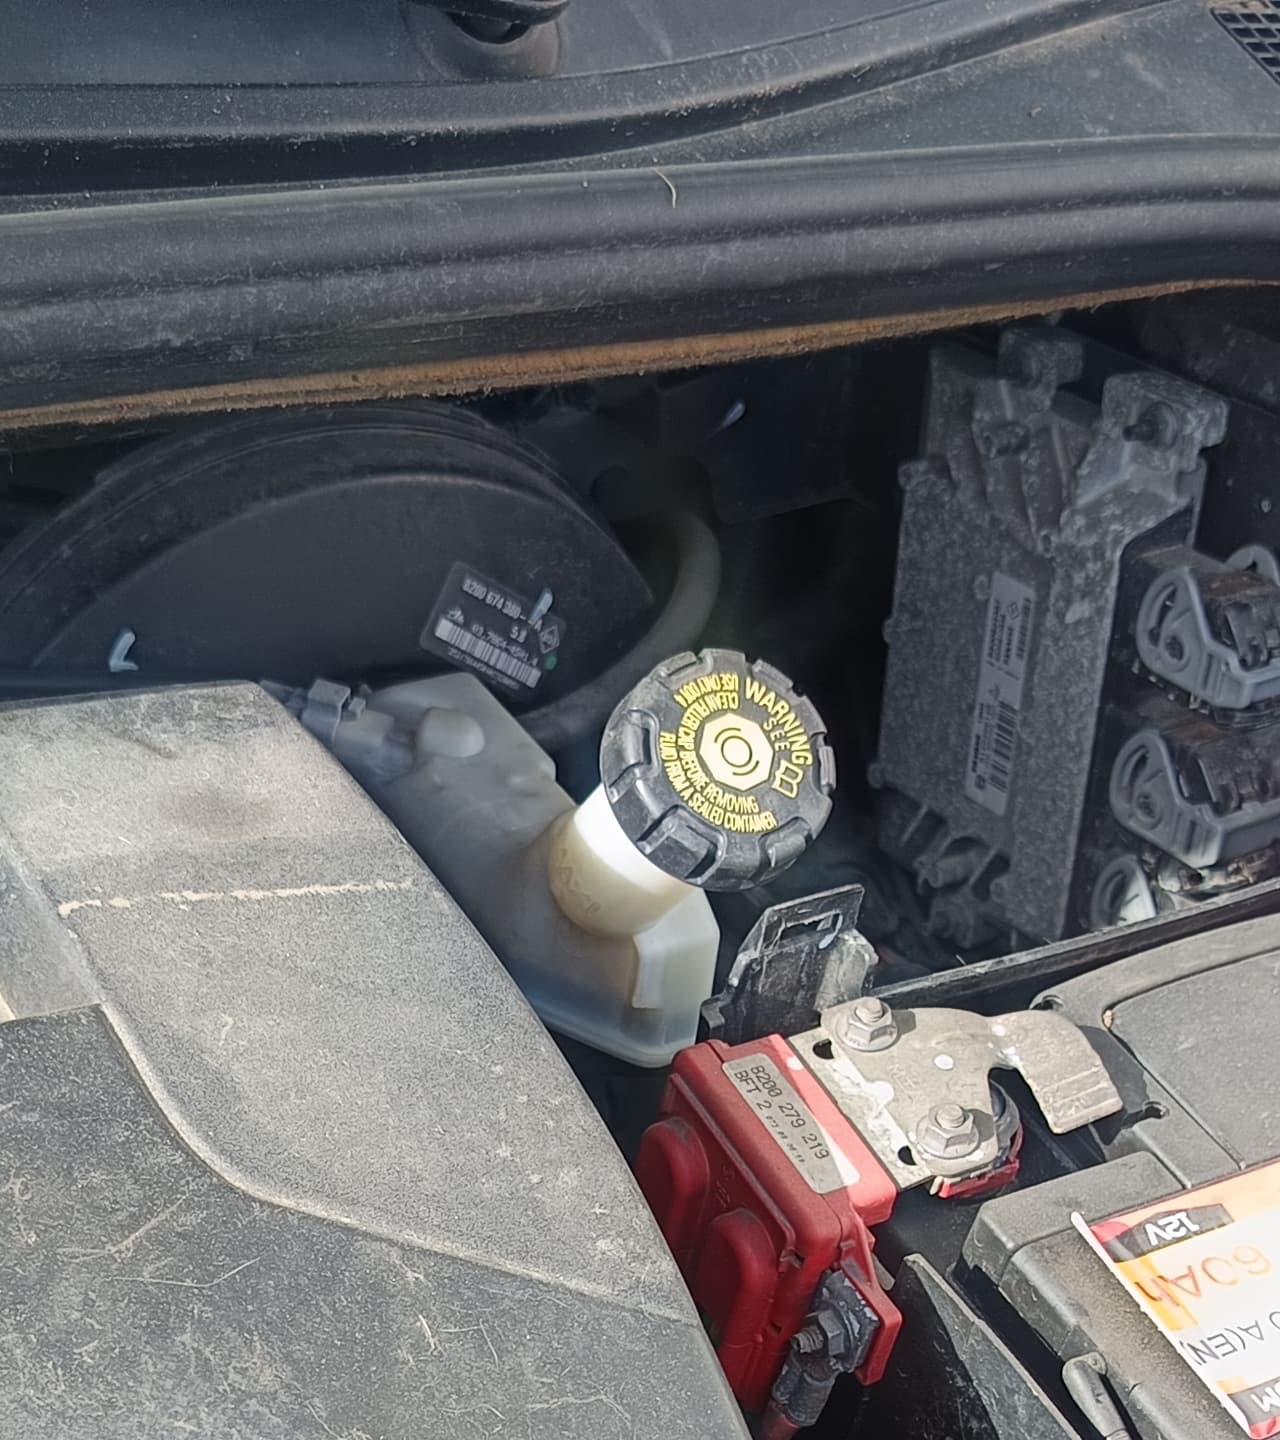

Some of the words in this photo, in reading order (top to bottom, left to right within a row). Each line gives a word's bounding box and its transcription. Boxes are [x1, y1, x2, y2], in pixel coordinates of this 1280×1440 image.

[697, 675, 721, 693] ONLY
[721, 674, 739, 691] USE
[682, 699, 710, 731] FILLER
[705, 691, 739, 713] CLEAN
[746, 677, 813, 766] WARNING
[763, 717, 790, 751] SEE
[659, 731, 678, 761] FLUID
[677, 726, 696, 750] CAP
[664, 760, 692, 792] FROM
[679, 750, 709, 792] BEFORE
[680, 786, 694, 801] A
[688, 792, 724, 825] SEALED
[703, 782, 760, 814] REMOVING
[724, 811, 778, 833] CONTAINER
[733, 1069, 761, 1093] BFT
[755, 1099, 772, 1110] 2
[750, 1065, 782, 1097] 8200
[777, 1102, 806, 1128] 279
[801, 1132, 830, 1159] 219
[1144, 1212, 1200, 1246] 12V
[1134, 1246, 1271, 1307] 60Ah
